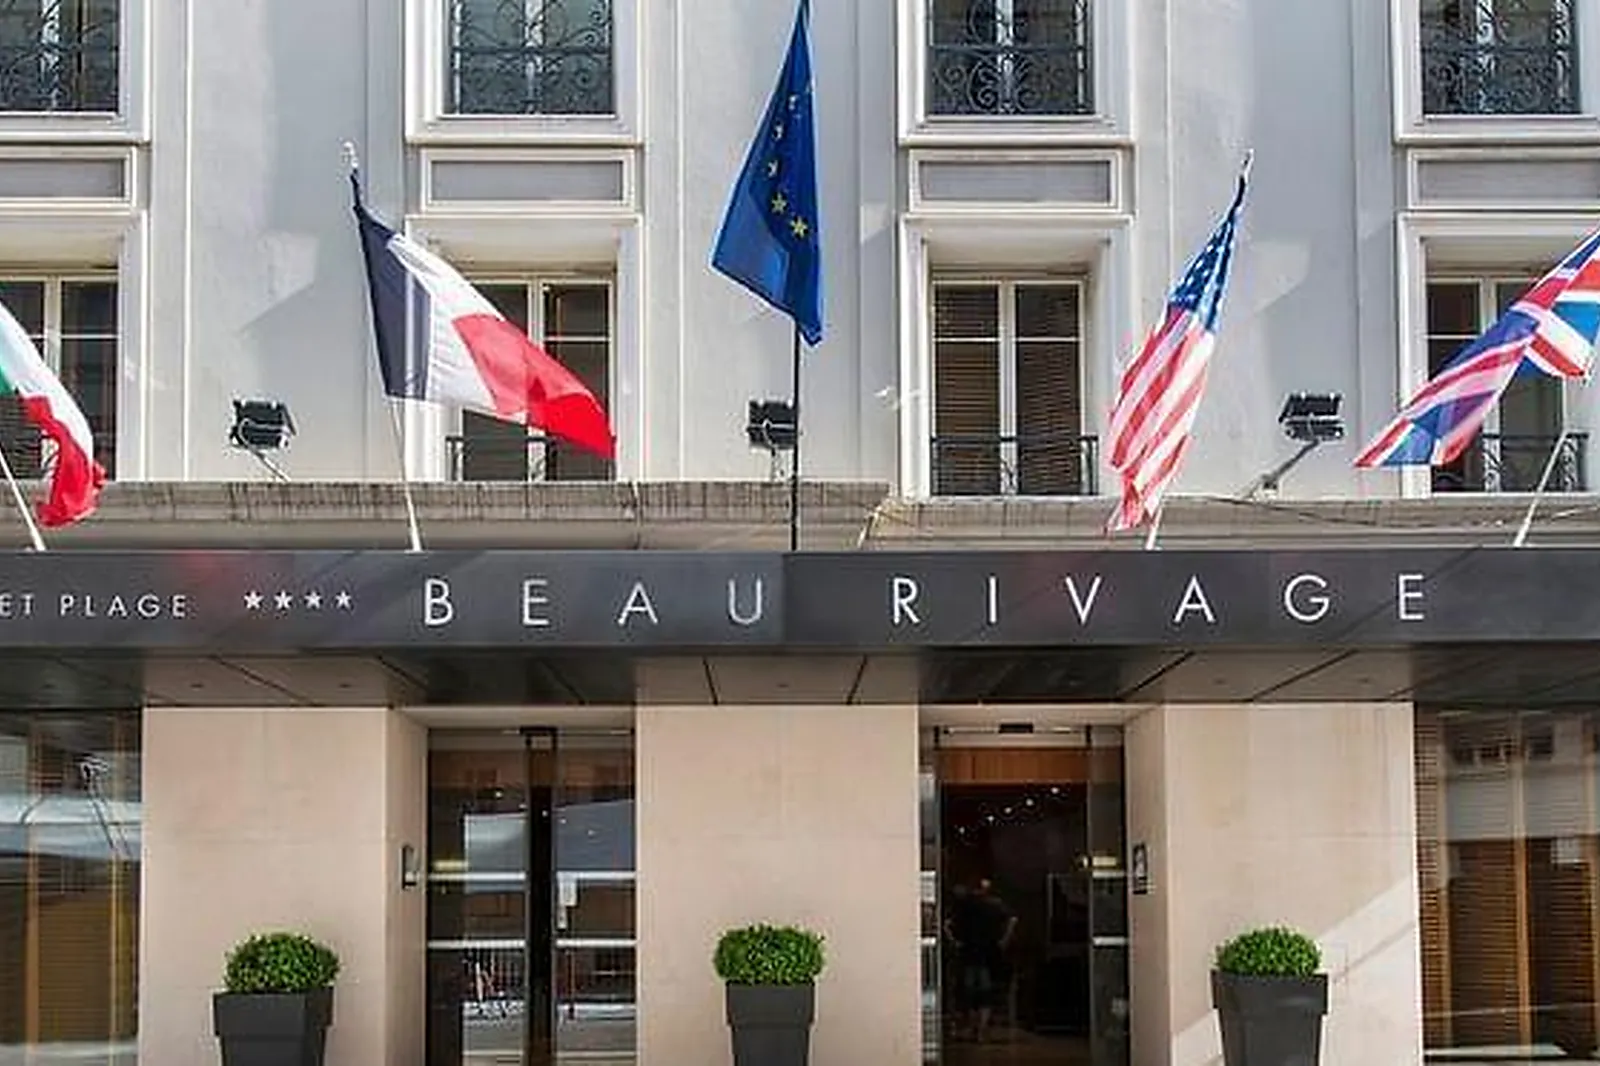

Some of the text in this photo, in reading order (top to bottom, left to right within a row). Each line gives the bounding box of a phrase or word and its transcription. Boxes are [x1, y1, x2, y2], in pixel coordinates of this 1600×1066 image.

[0, 593, 187, 617] ET PLAGE
[424, 573, 1426, 626] BEAU RIVAGE
